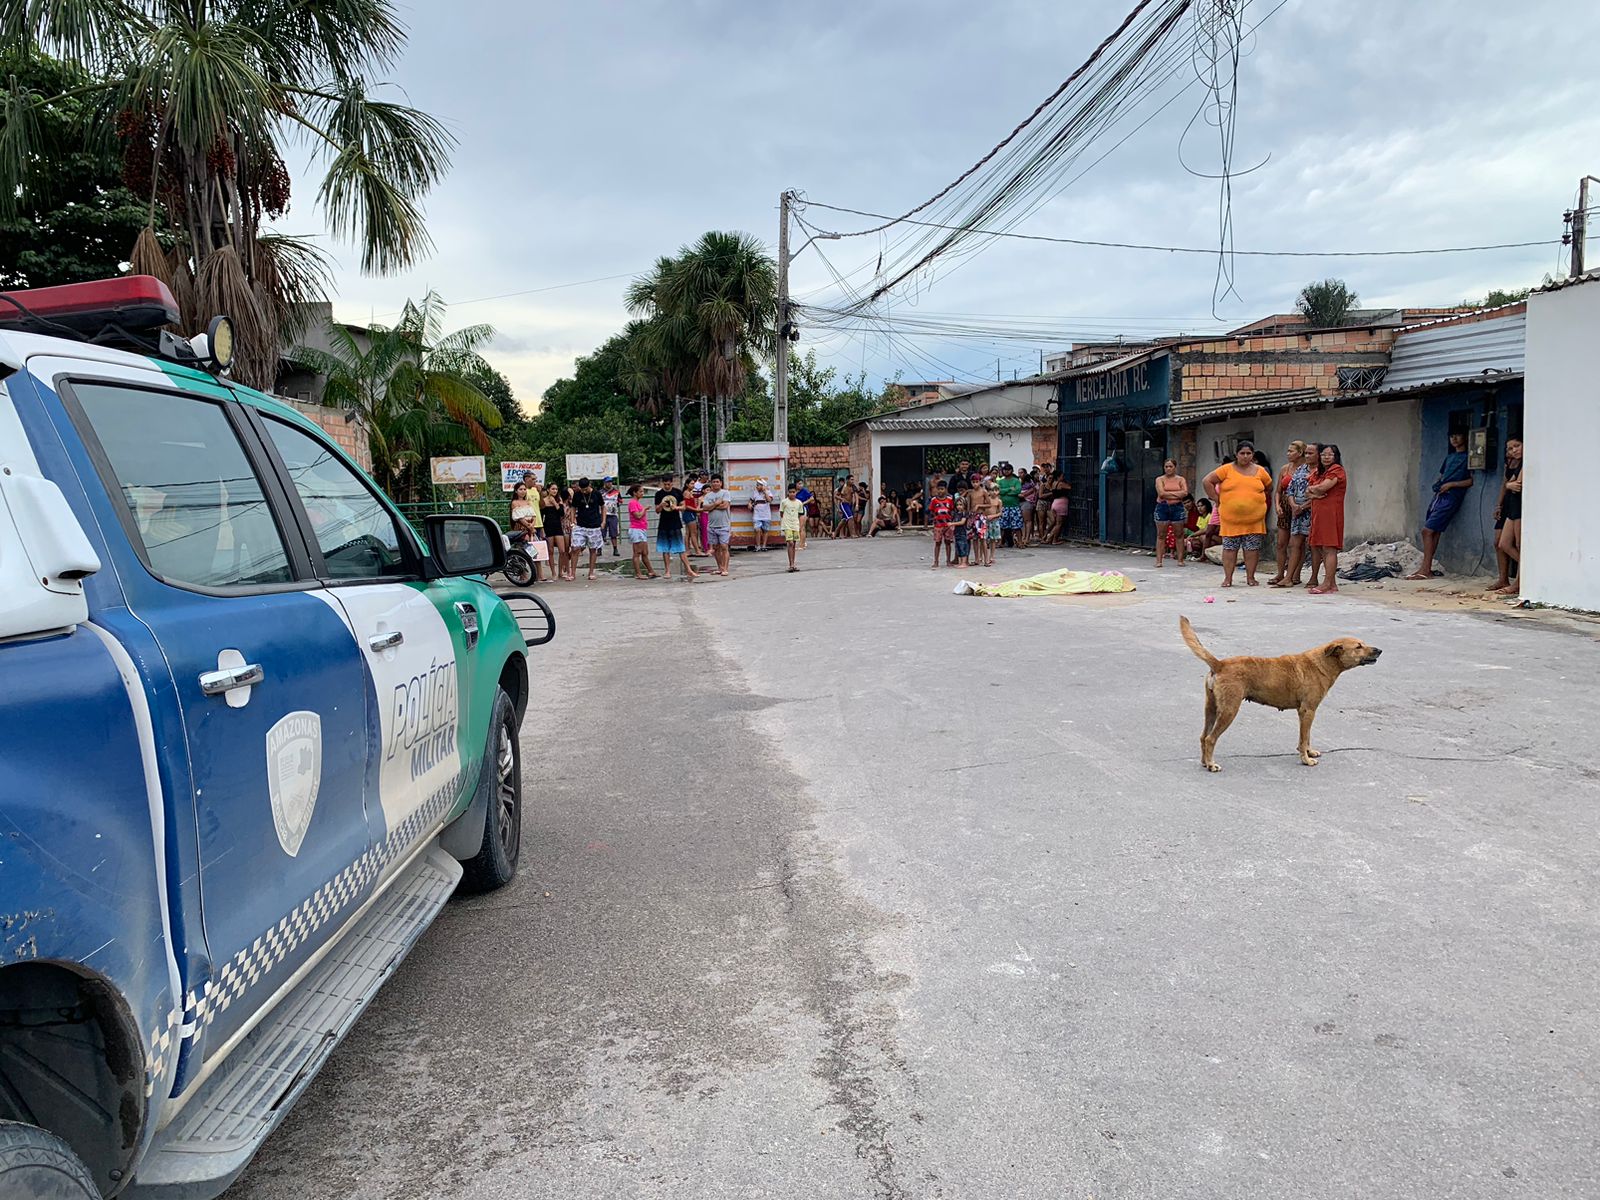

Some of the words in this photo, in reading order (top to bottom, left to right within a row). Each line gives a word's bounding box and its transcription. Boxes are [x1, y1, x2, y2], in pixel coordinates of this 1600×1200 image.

[1076, 371, 1128, 403] MERCEARIA
[387, 656, 456, 761] POLÍCIA
[270, 718, 318, 756] AMAZONAS
[410, 724, 455, 782] MILITAR
